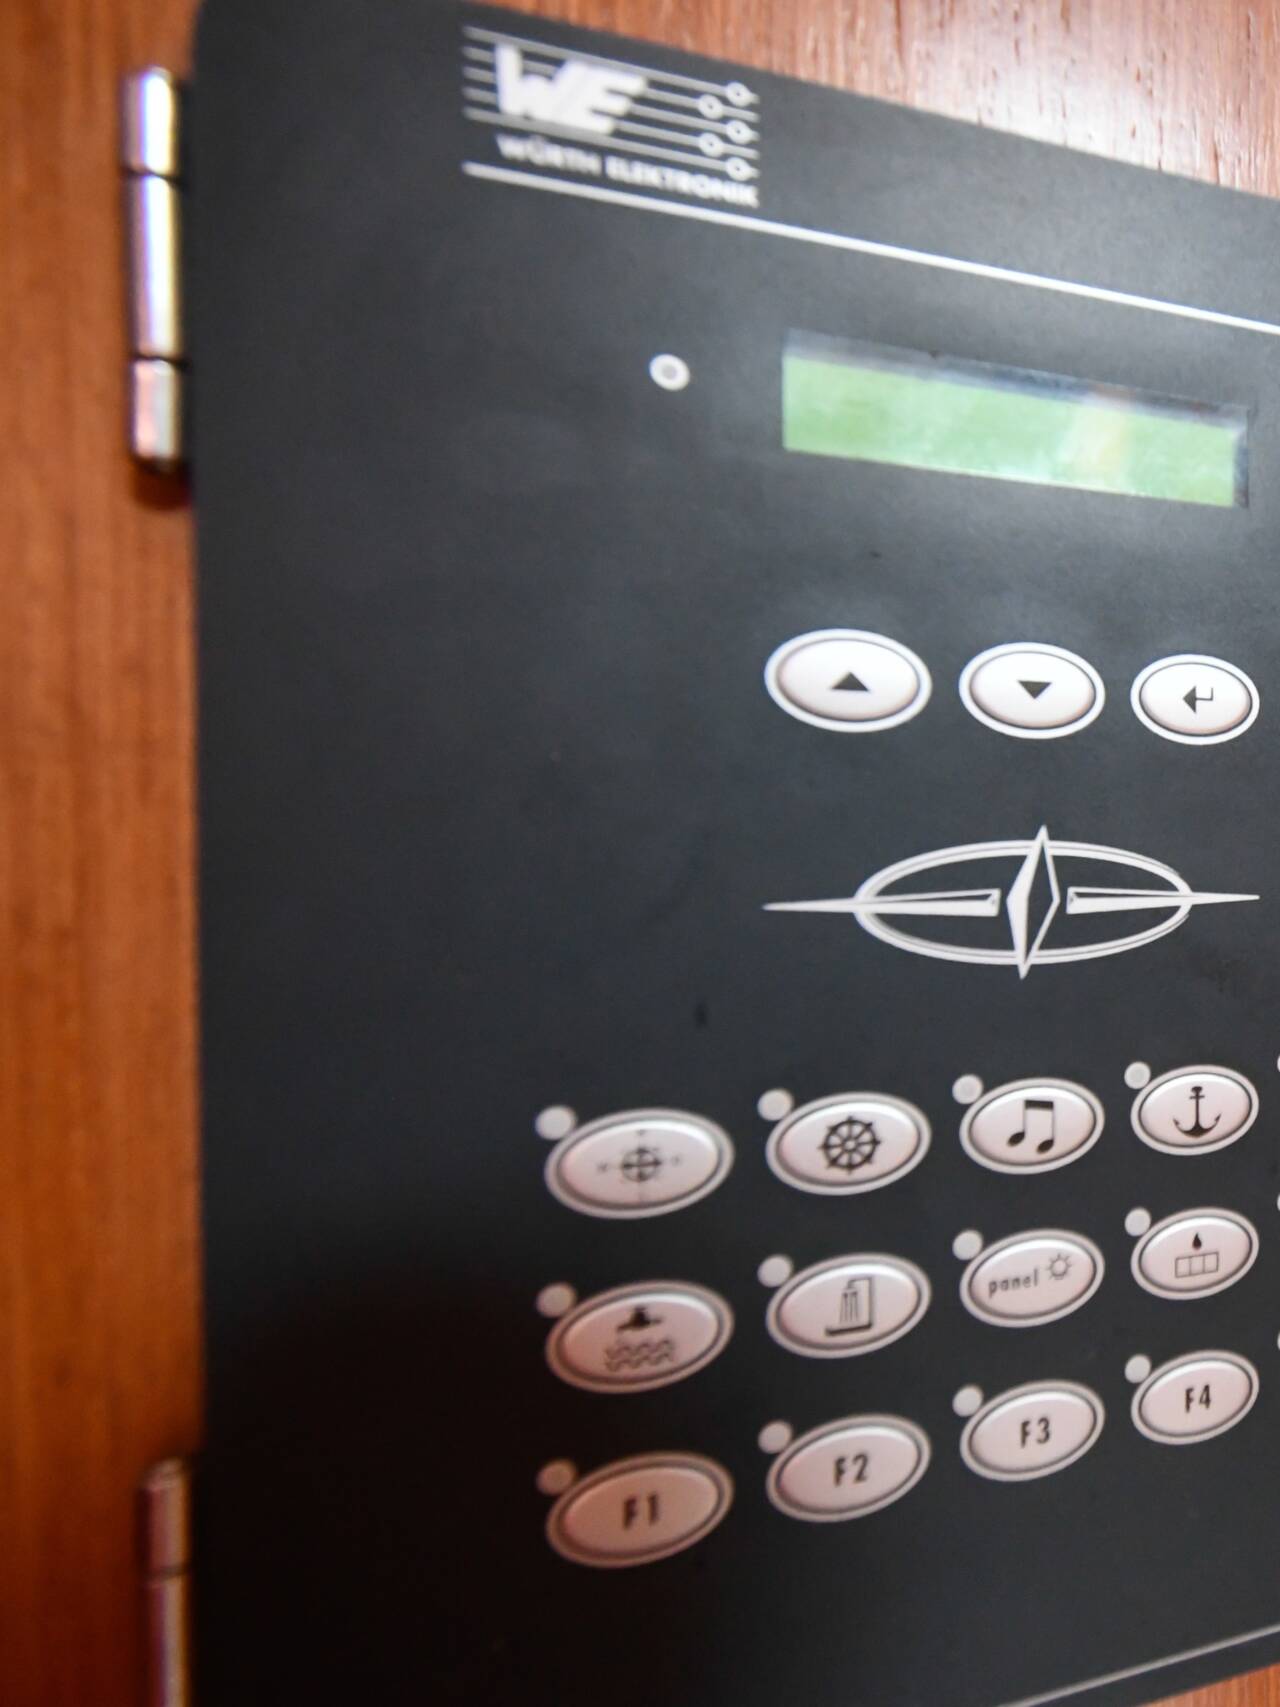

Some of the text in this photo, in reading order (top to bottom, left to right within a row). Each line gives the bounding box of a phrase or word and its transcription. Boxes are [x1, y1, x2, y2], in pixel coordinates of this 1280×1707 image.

[604, 155, 761, 208] ELEKTRONIK
[988, 1267, 1038, 1299] panel
[1184, 1383, 1213, 1413] F4
[1019, 1415, 1052, 1449] F3
[832, 1452, 870, 1487] F2
[622, 1493, 661, 1531] F1
